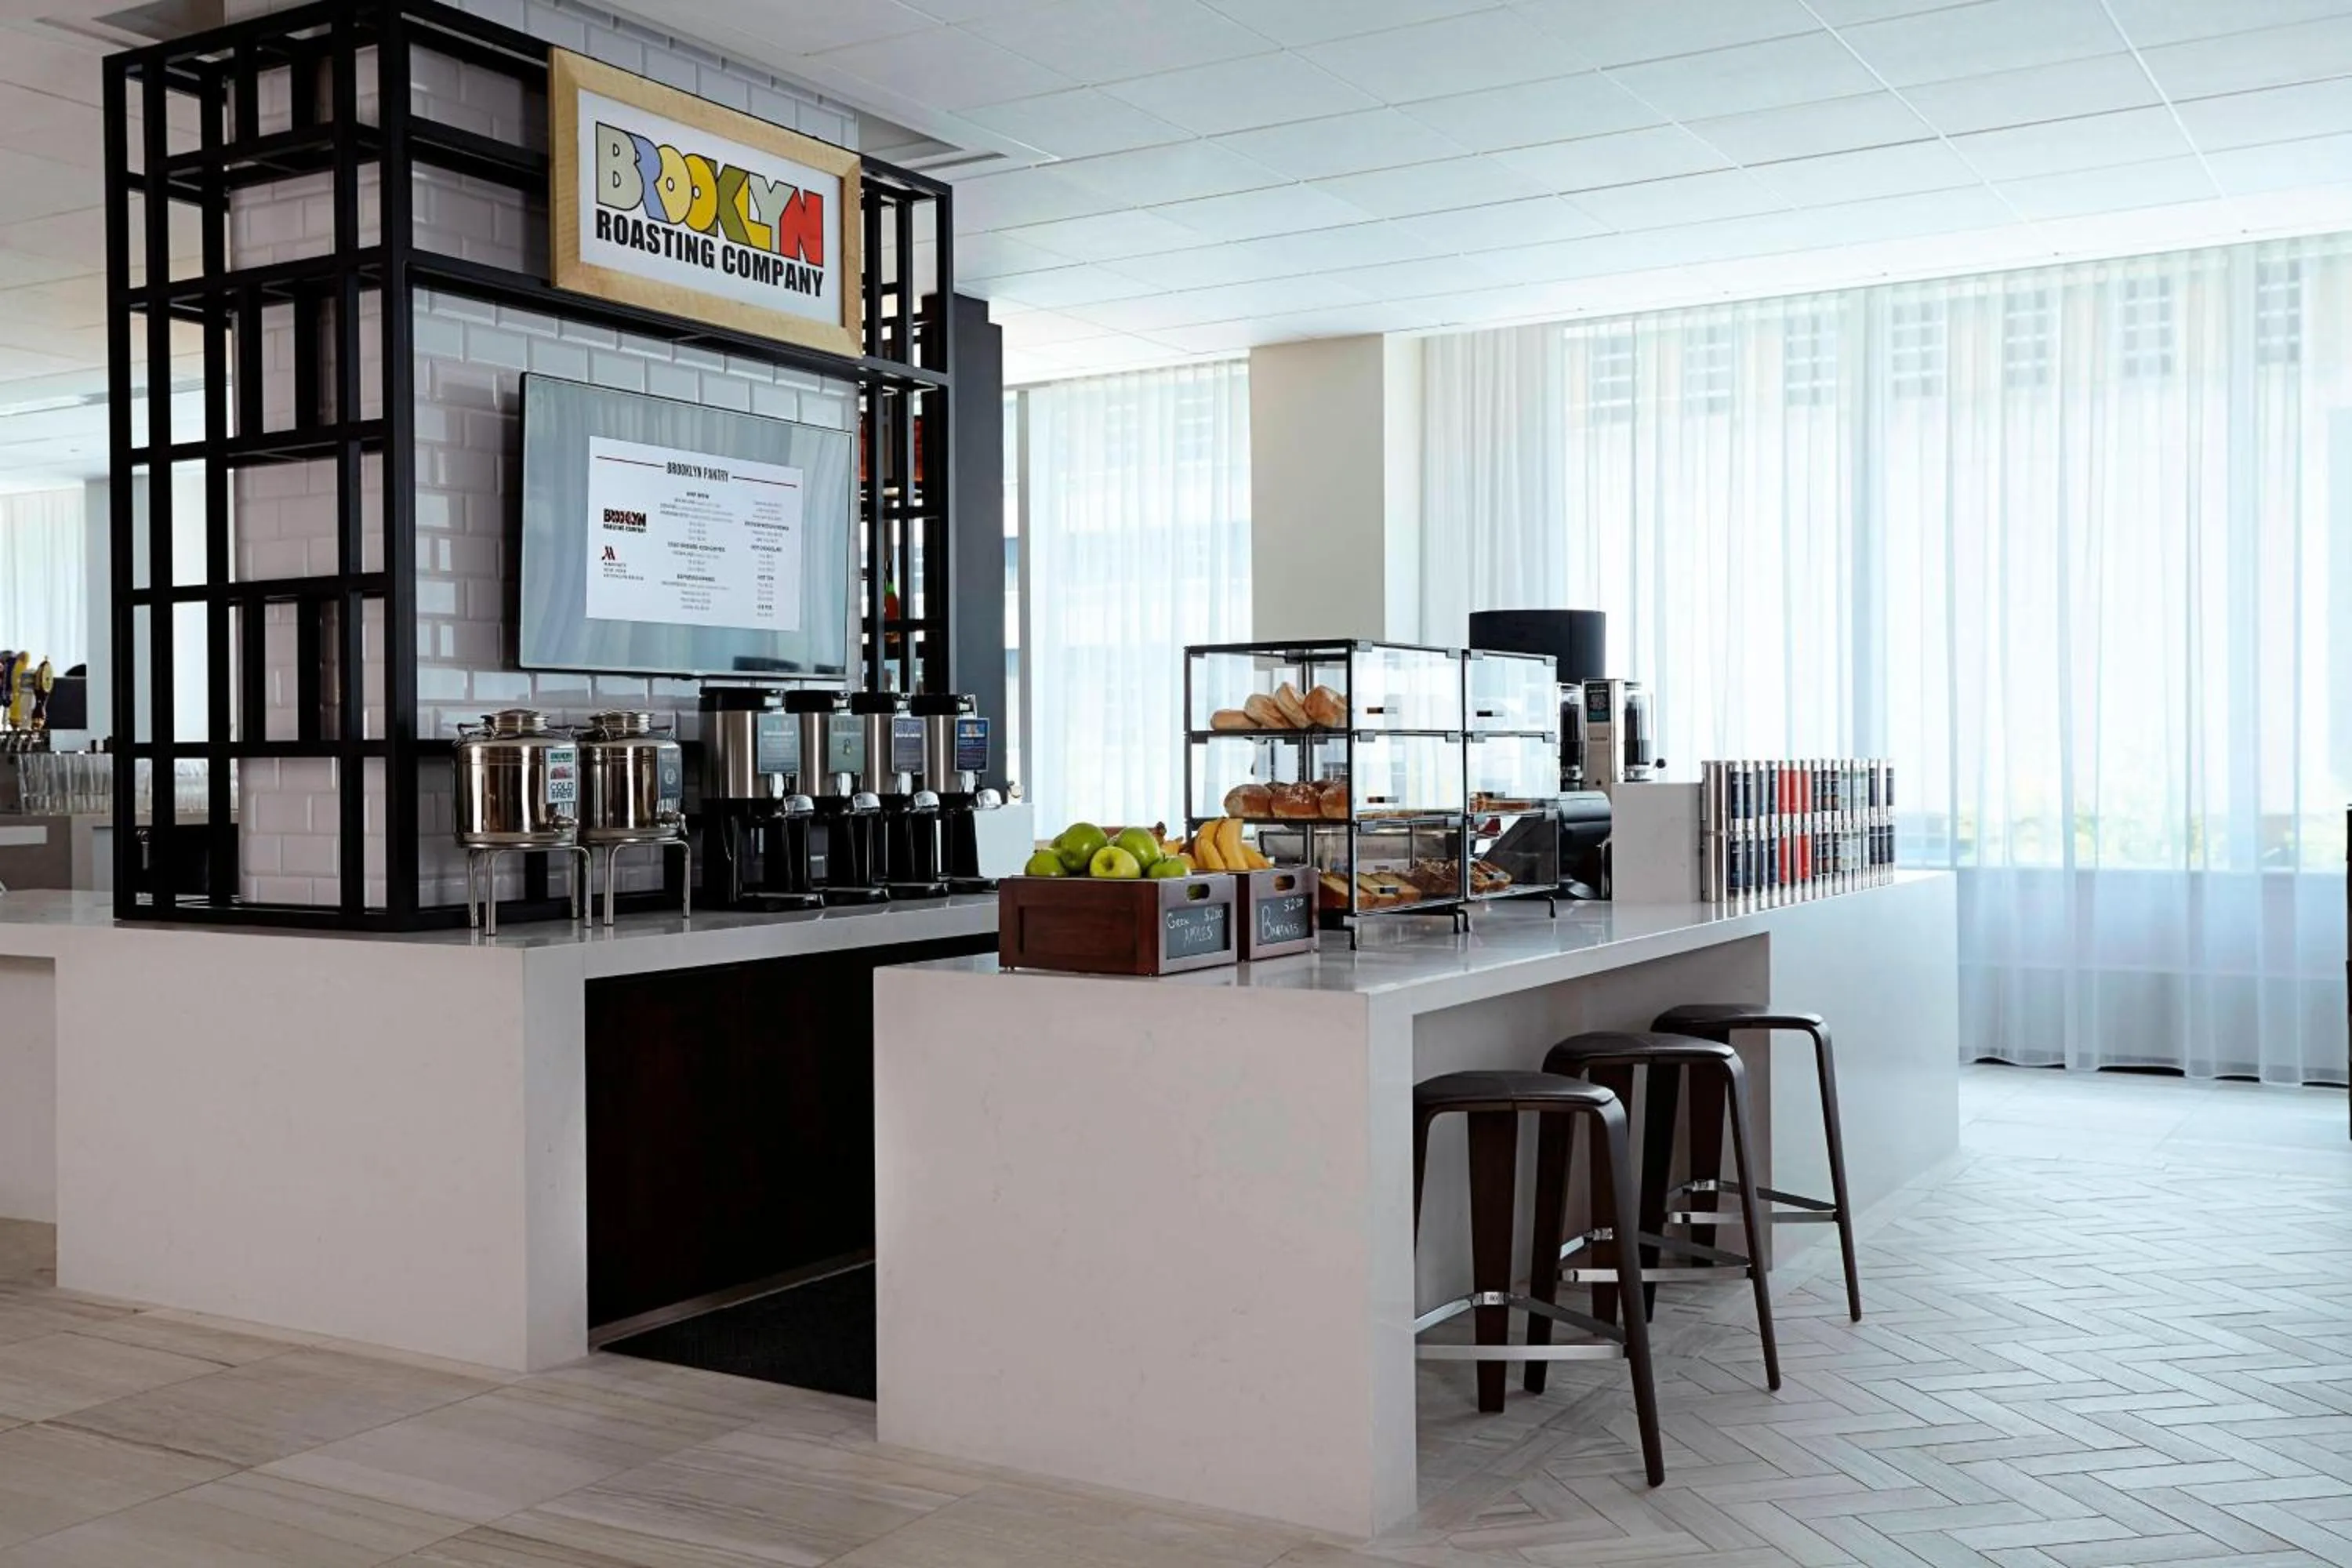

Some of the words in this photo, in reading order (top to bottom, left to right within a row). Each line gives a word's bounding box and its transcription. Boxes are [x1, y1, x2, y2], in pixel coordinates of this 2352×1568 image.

[596, 120, 824, 267] BROOKLYN
[596, 208, 715, 270] ROASTING
[721, 245, 824, 298] COMPANY
[666, 461, 702, 477] BROOKLYN
[703, 466, 729, 483] PANTRY
